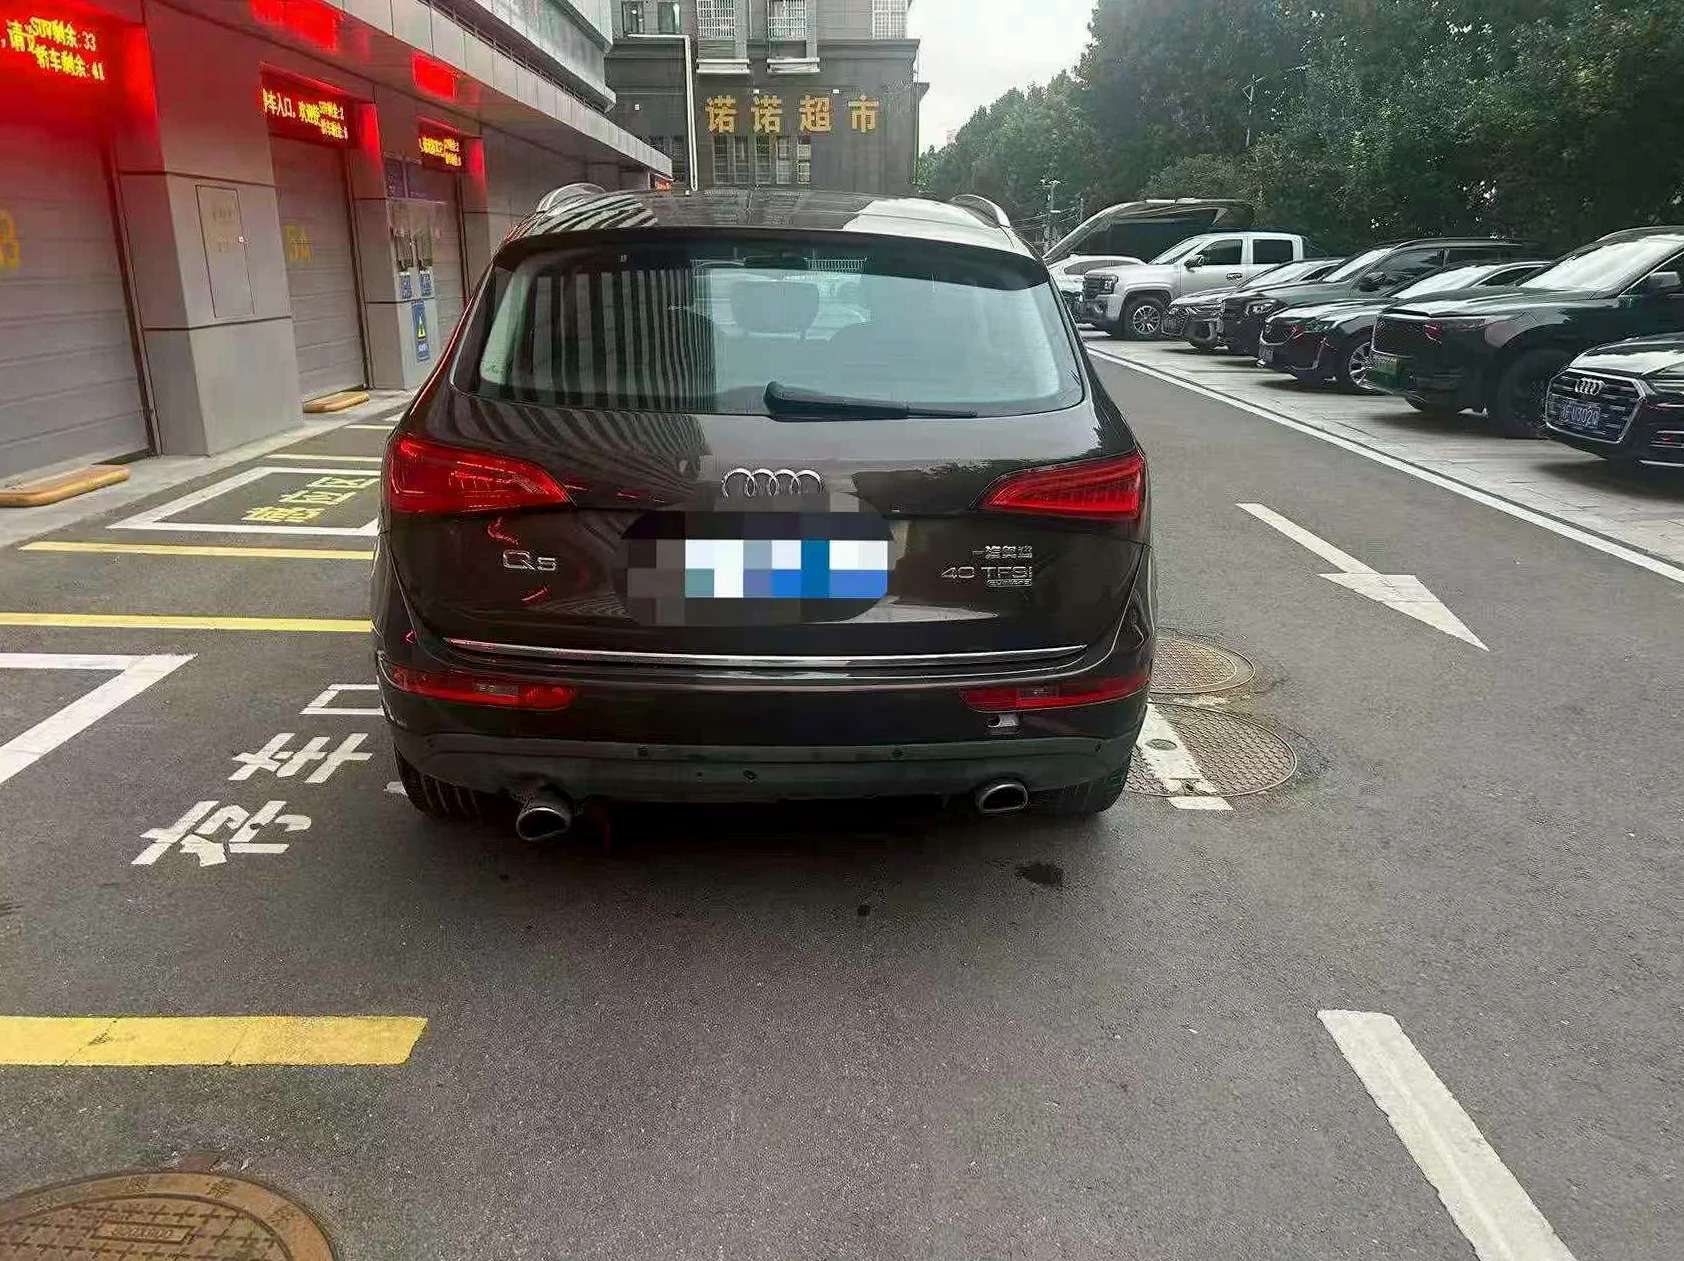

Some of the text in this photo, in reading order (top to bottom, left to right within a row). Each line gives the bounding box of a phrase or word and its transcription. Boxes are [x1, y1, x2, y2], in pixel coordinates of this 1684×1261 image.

[704, 95, 880, 134] 诺诺超市
[503, 550, 556, 571] Q5
[941, 566, 975, 579] 40
